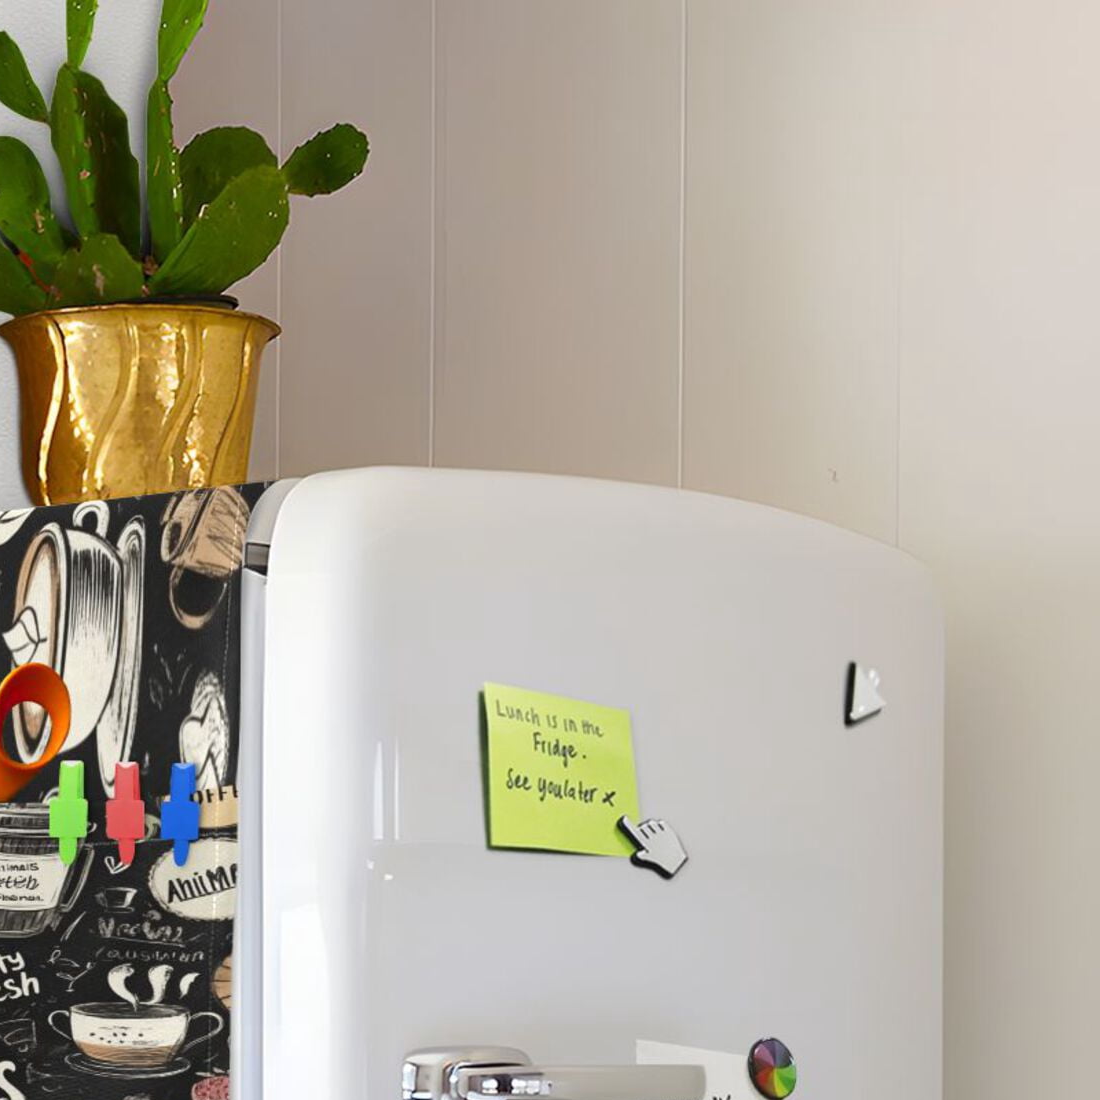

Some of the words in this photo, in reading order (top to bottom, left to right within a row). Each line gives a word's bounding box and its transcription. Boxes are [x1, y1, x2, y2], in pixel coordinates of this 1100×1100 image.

[496, 699, 540, 727] Lunch
[582, 720, 604, 737] the
[506, 768, 532, 791] See
